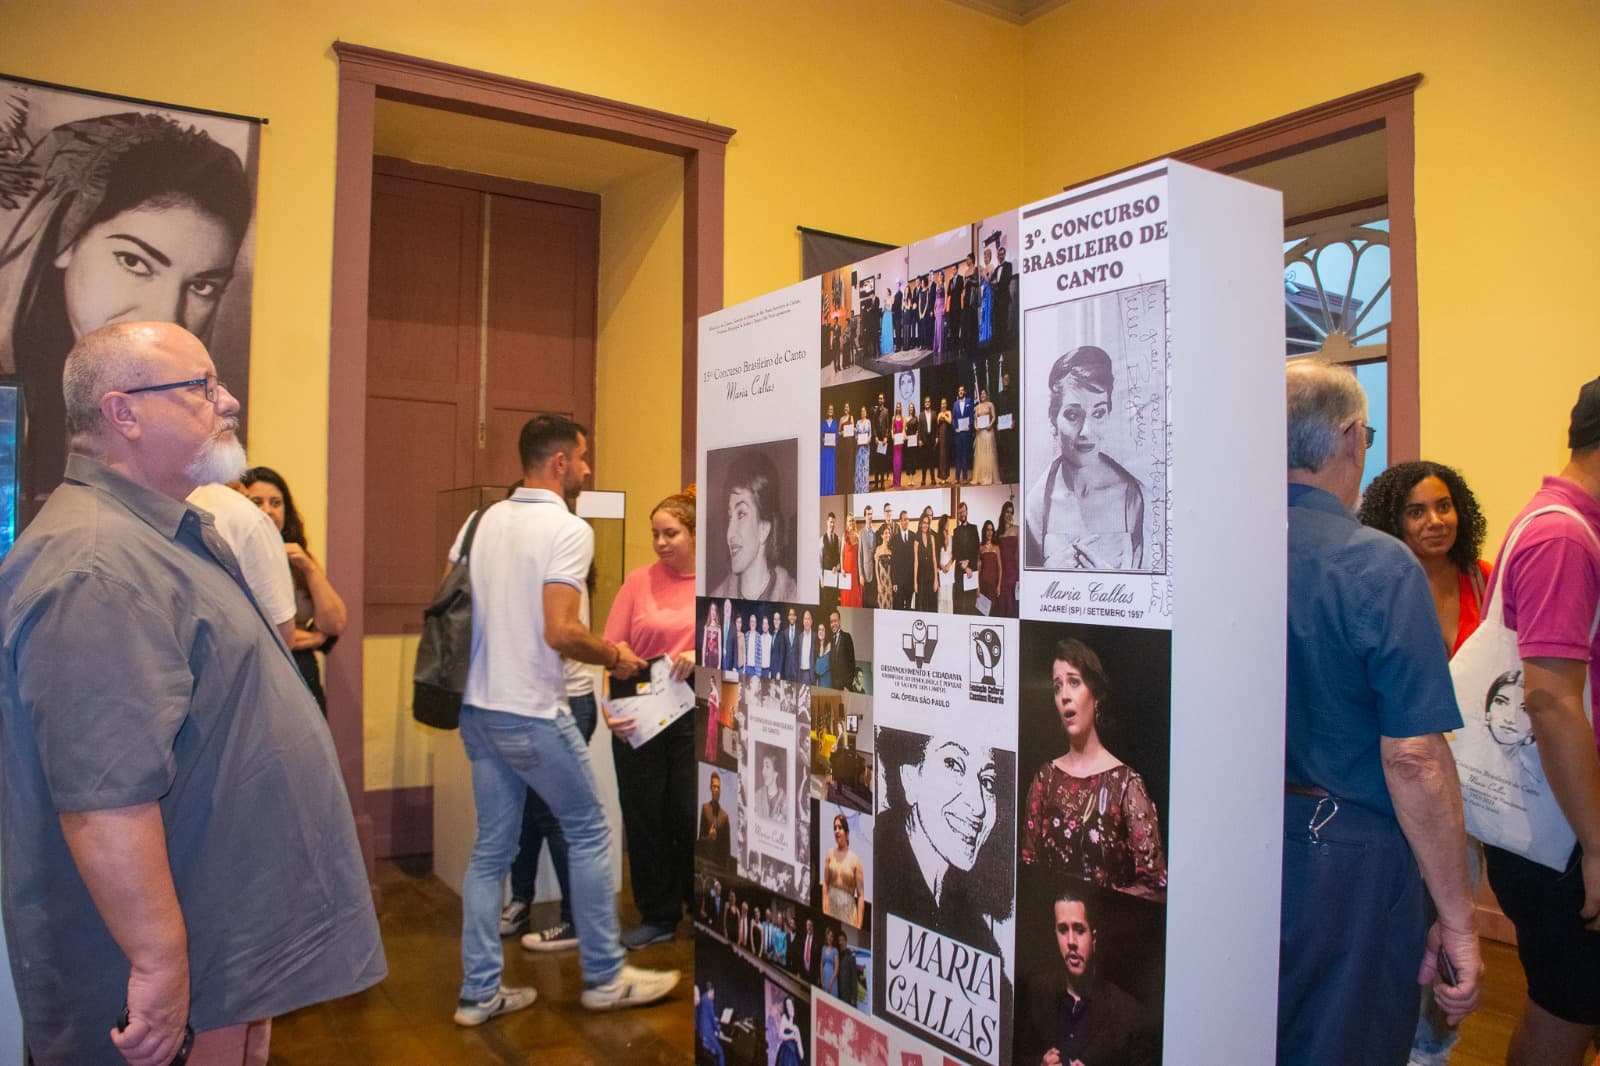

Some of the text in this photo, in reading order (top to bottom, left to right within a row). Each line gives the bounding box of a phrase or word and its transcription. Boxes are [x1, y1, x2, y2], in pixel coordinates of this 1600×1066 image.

[1051, 194, 1160, 241] CONCURSO
[1023, 220, 1168, 274] BRASILEIRO DE
[1056, 260, 1124, 291] CANTO
[714, 365, 742, 380] Concurso
[743, 357, 774, 373] Brasileiro
[774, 352, 783, 365] de
[784, 348, 807, 363] Canto
[726, 372, 775, 401] Maria Callas
[1040, 580, 1134, 604] Maria Callas
[1040, 604, 1068, 614] JACAREÍ
[1087, 607, 1126, 618] SETEMBRO
[932, 671, 962, 682] CIDADANIA
[932, 699, 950, 708] PAULO
[889, 924, 997, 1005] MARIA
[888, 974, 997, 1057] CALLAS
